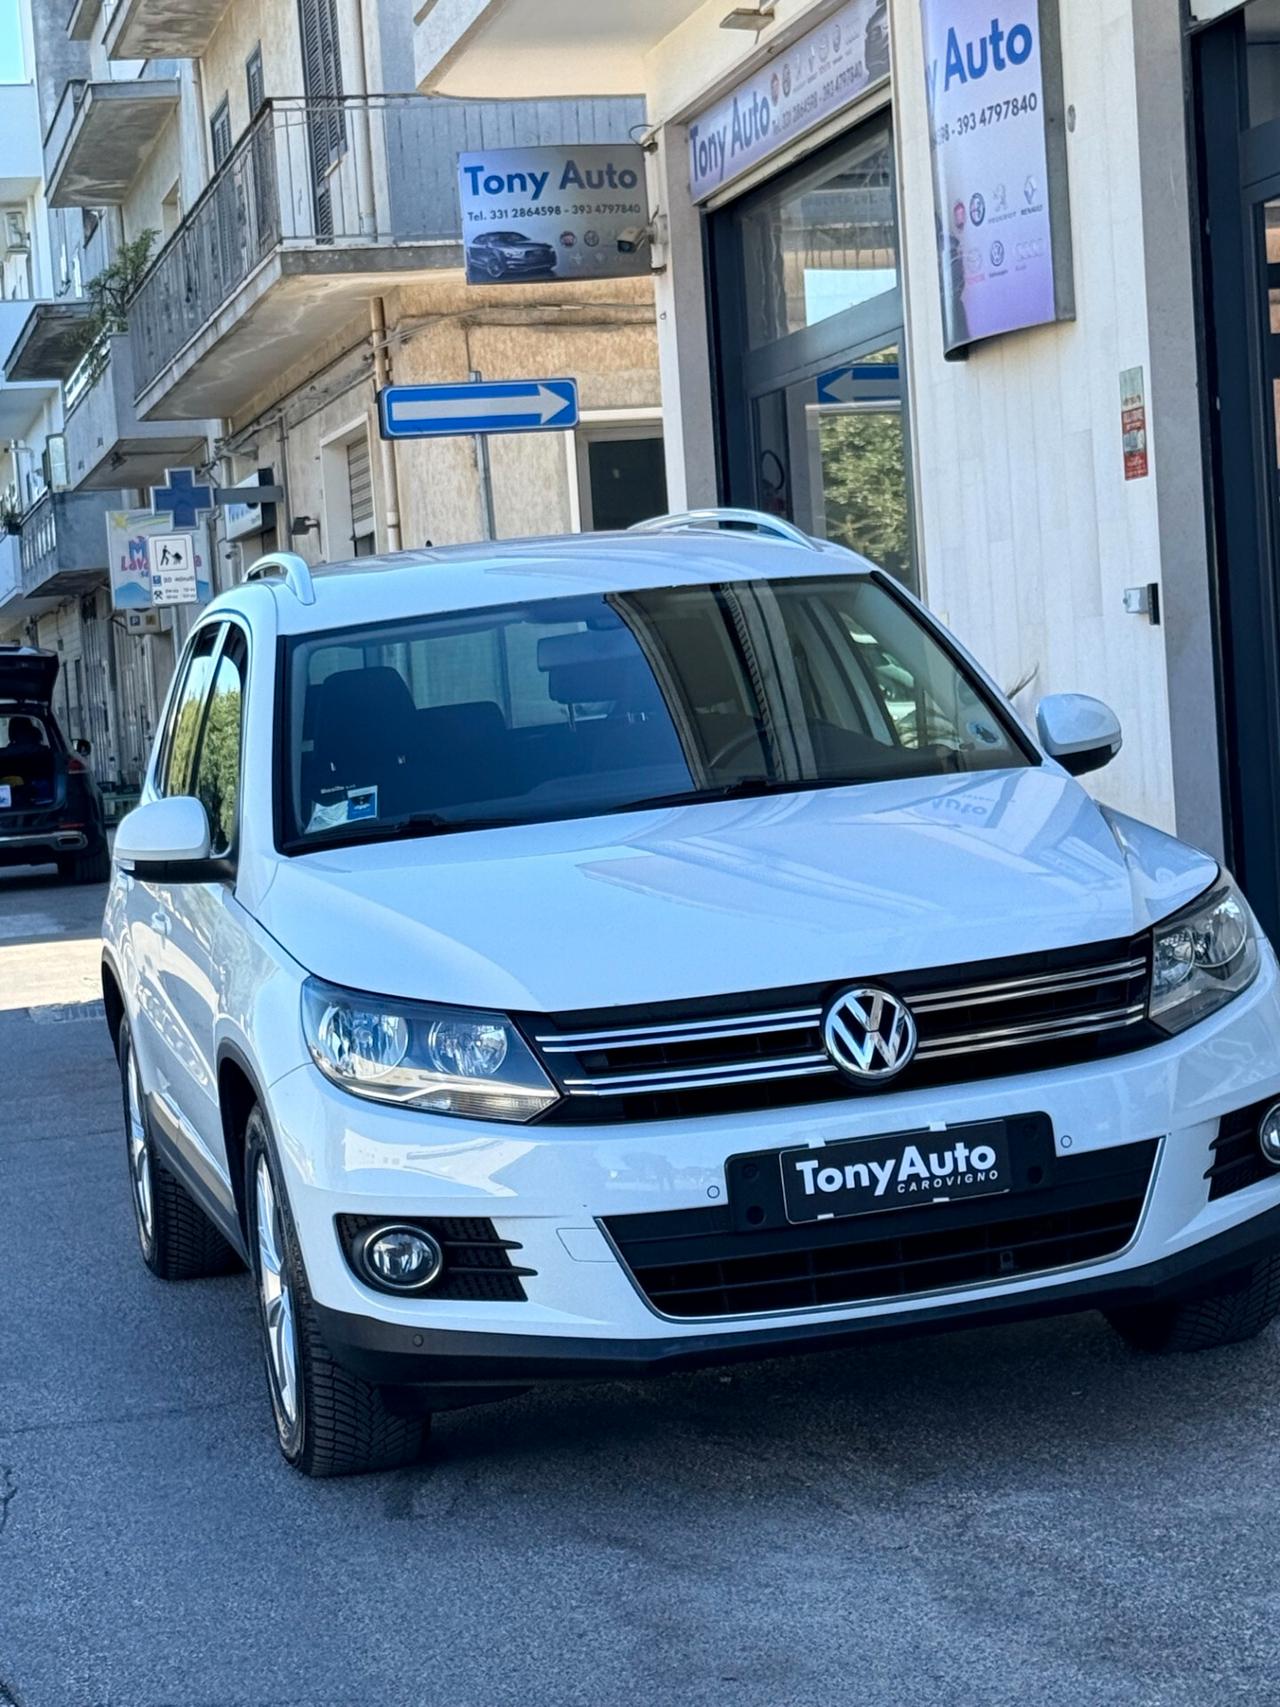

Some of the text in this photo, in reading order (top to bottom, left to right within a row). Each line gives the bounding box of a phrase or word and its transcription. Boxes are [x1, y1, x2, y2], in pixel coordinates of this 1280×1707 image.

[943, 17, 1033, 93] Auto
[957, 113, 977, 137] 393
[978, 92, 1038, 128] 4797840
[689, 124, 728, 183] Tony
[731, 90, 771, 158] Auto
[463, 159, 638, 201] Tony Auto
[467, 211, 487, 222] Tel.
[489, 208, 508, 219] 331
[511, 204, 561, 219] 2864598
[571, 204, 592, 215] 393
[594, 203, 641, 215] 4797840
[897, 1170, 999, 1194] CAROVIGNO
